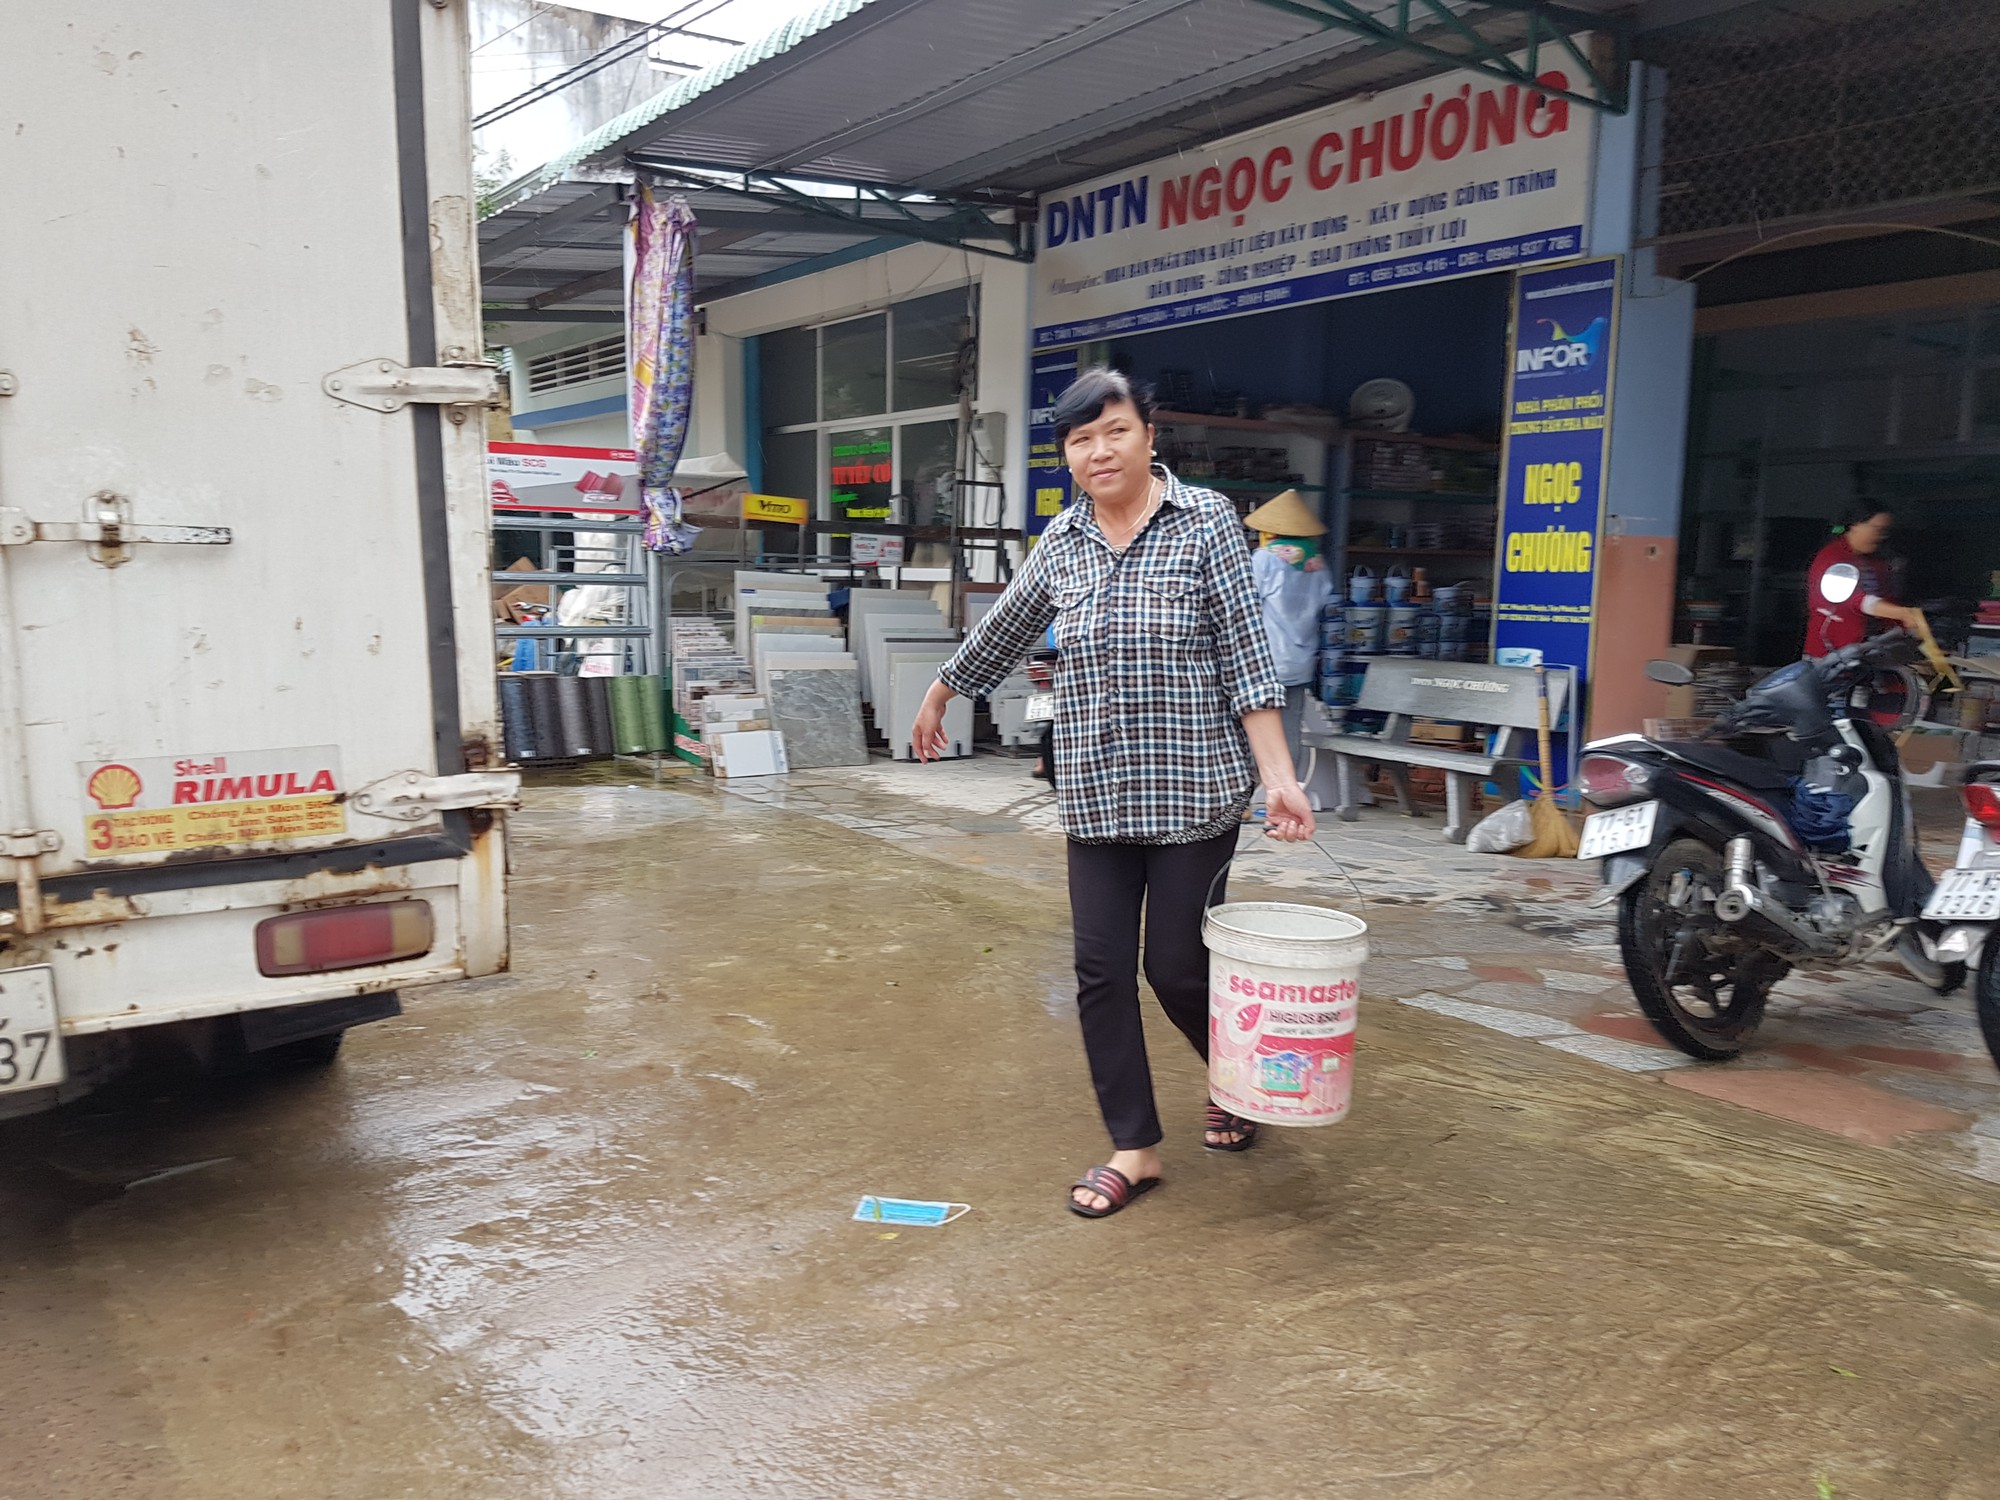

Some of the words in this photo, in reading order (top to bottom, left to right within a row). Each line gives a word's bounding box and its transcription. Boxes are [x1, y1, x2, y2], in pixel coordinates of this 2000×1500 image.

[1046, 175, 1148, 249] DNTN
[1159, 146, 1292, 229] NGỌC
[1308, 71, 1570, 189] CHƯƠNG
[1455, 181, 1498, 206] CÔNG
[1506, 168, 1556, 196] TRÌNH
[1516, 343, 1589, 373] INFOR
[1523, 461, 1583, 512] NGỌC
[1505, 524, 1593, 574] CHƯƠNG
[174, 756, 227, 778] Shell
[172, 769, 337, 805] RIMULA
[91, 818, 113, 850] 3
